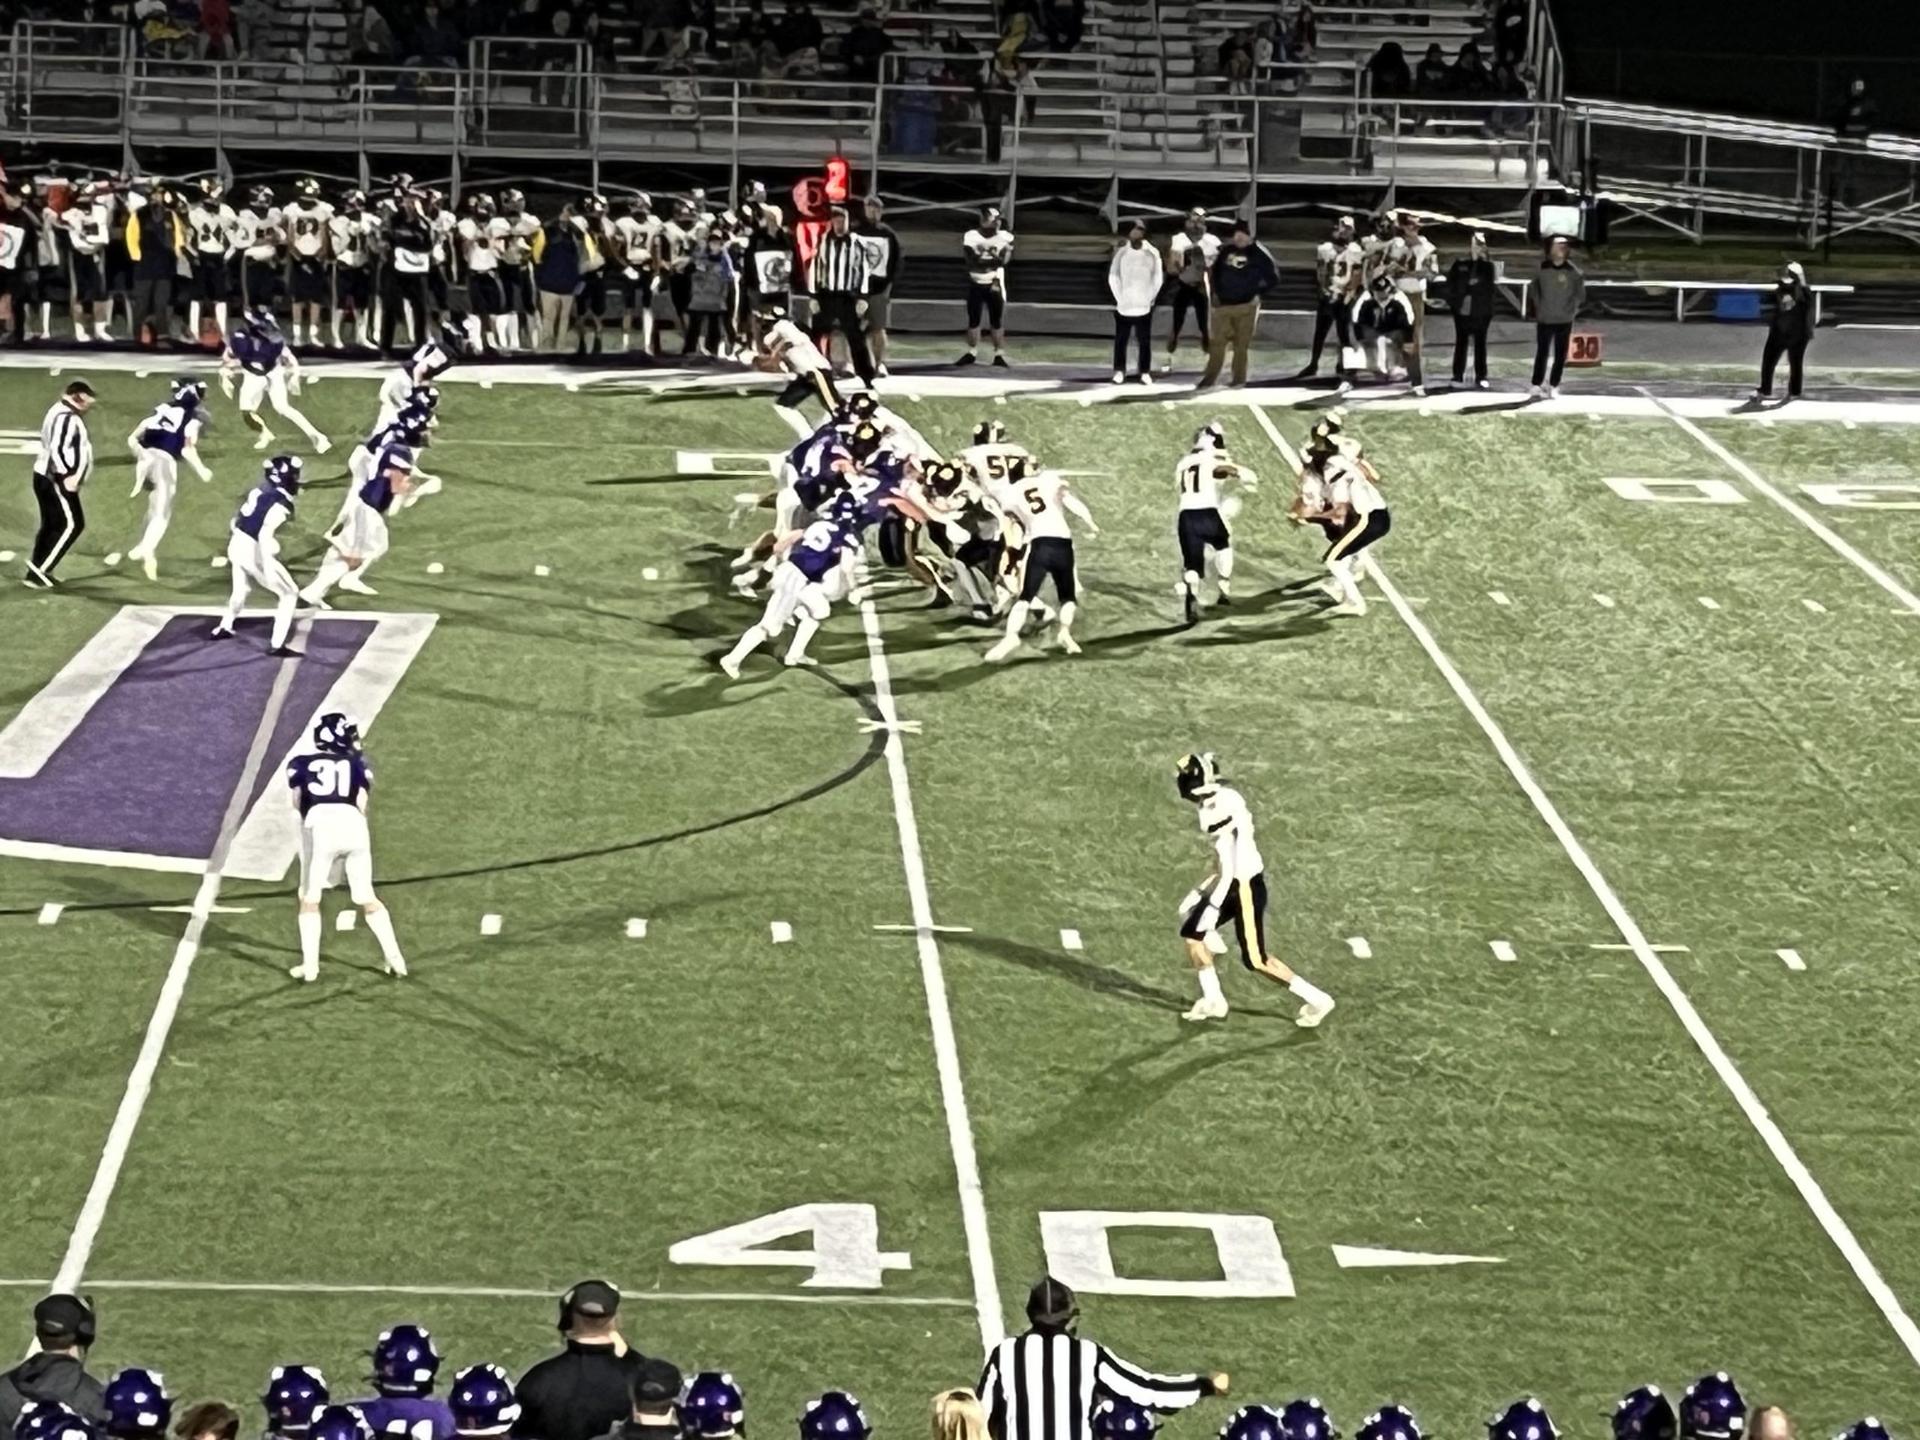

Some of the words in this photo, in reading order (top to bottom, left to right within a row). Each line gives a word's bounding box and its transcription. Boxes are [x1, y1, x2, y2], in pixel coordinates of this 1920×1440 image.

[1572, 336, 1599, 360] 30
[1024, 488, 1046, 514] 5
[307, 759, 350, 797] 31
